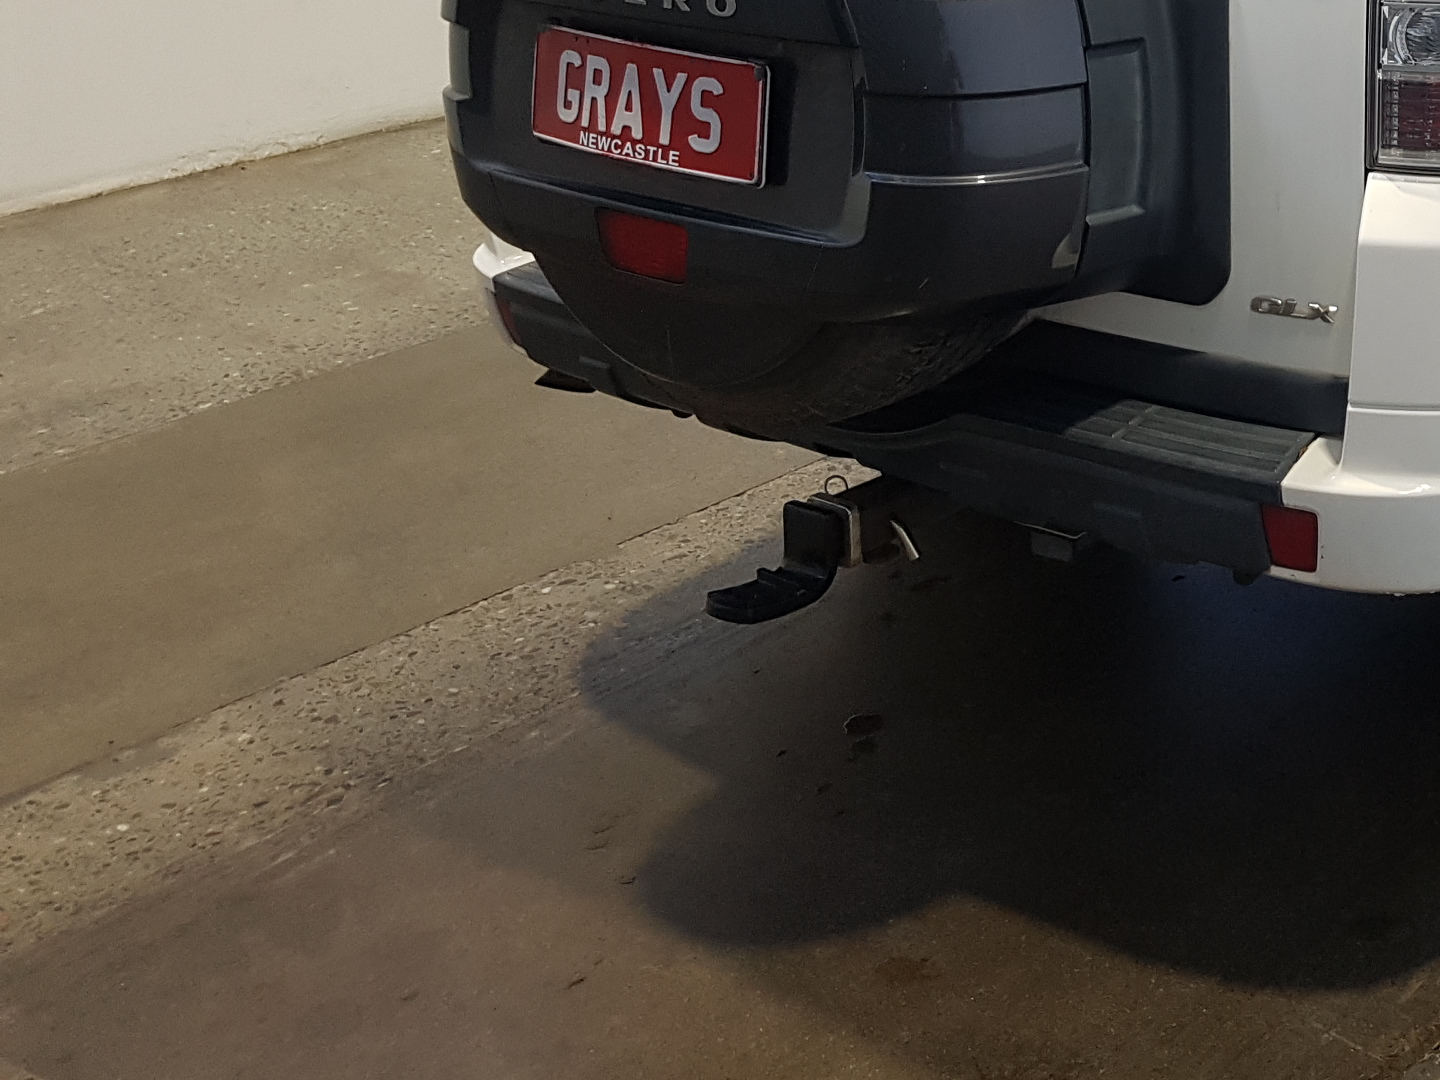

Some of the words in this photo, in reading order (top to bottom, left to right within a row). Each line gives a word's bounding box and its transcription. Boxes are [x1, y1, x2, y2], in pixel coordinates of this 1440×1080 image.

[556, 48, 725, 155] GRAYS
[578, 130, 681, 167] NEWCASTLE
[1250, 295, 1339, 324] GLX
